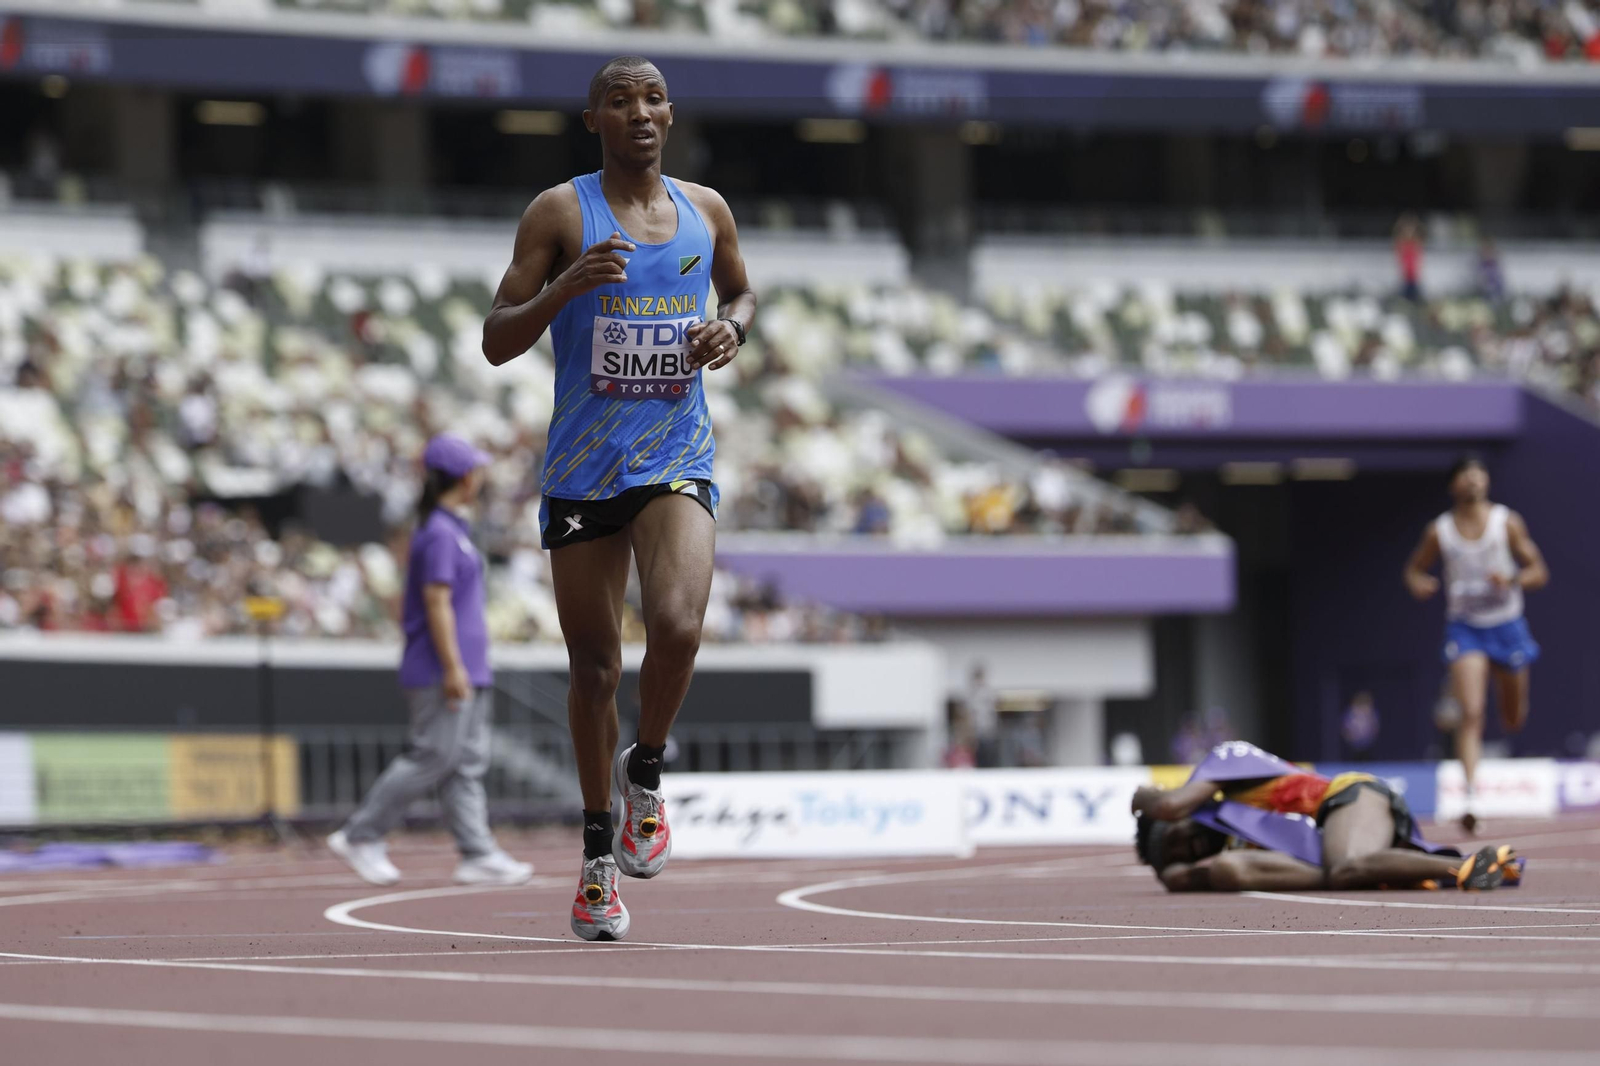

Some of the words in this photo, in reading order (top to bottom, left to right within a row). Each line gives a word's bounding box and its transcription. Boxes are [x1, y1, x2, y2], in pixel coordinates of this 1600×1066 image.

[599, 294, 697, 316] TANZANIA
[628, 320, 694, 346] TDK
[602, 350, 693, 377] SIMBU
[796, 788, 925, 837] Tokyo
